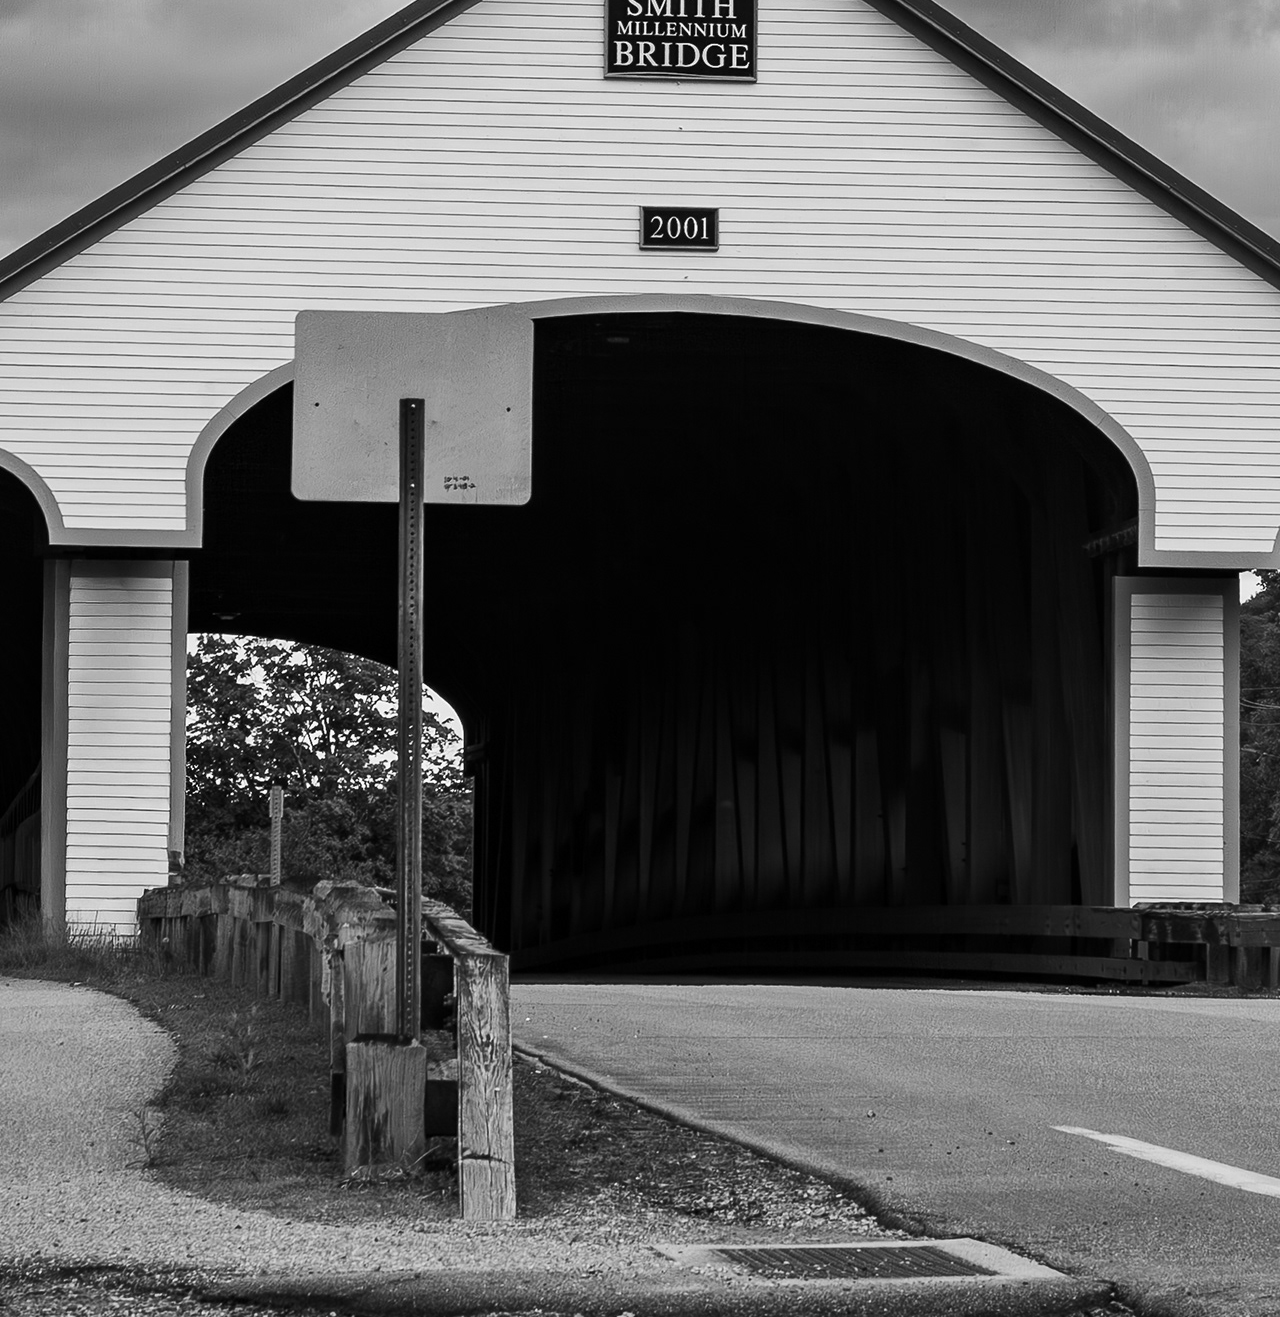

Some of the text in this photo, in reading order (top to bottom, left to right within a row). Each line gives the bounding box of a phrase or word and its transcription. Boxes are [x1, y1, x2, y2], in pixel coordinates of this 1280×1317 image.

[617, 21, 747, 38] MILLENNIUM
[613, 41, 750, 69] BRIDGE
[650, 216, 709, 239] 2001
